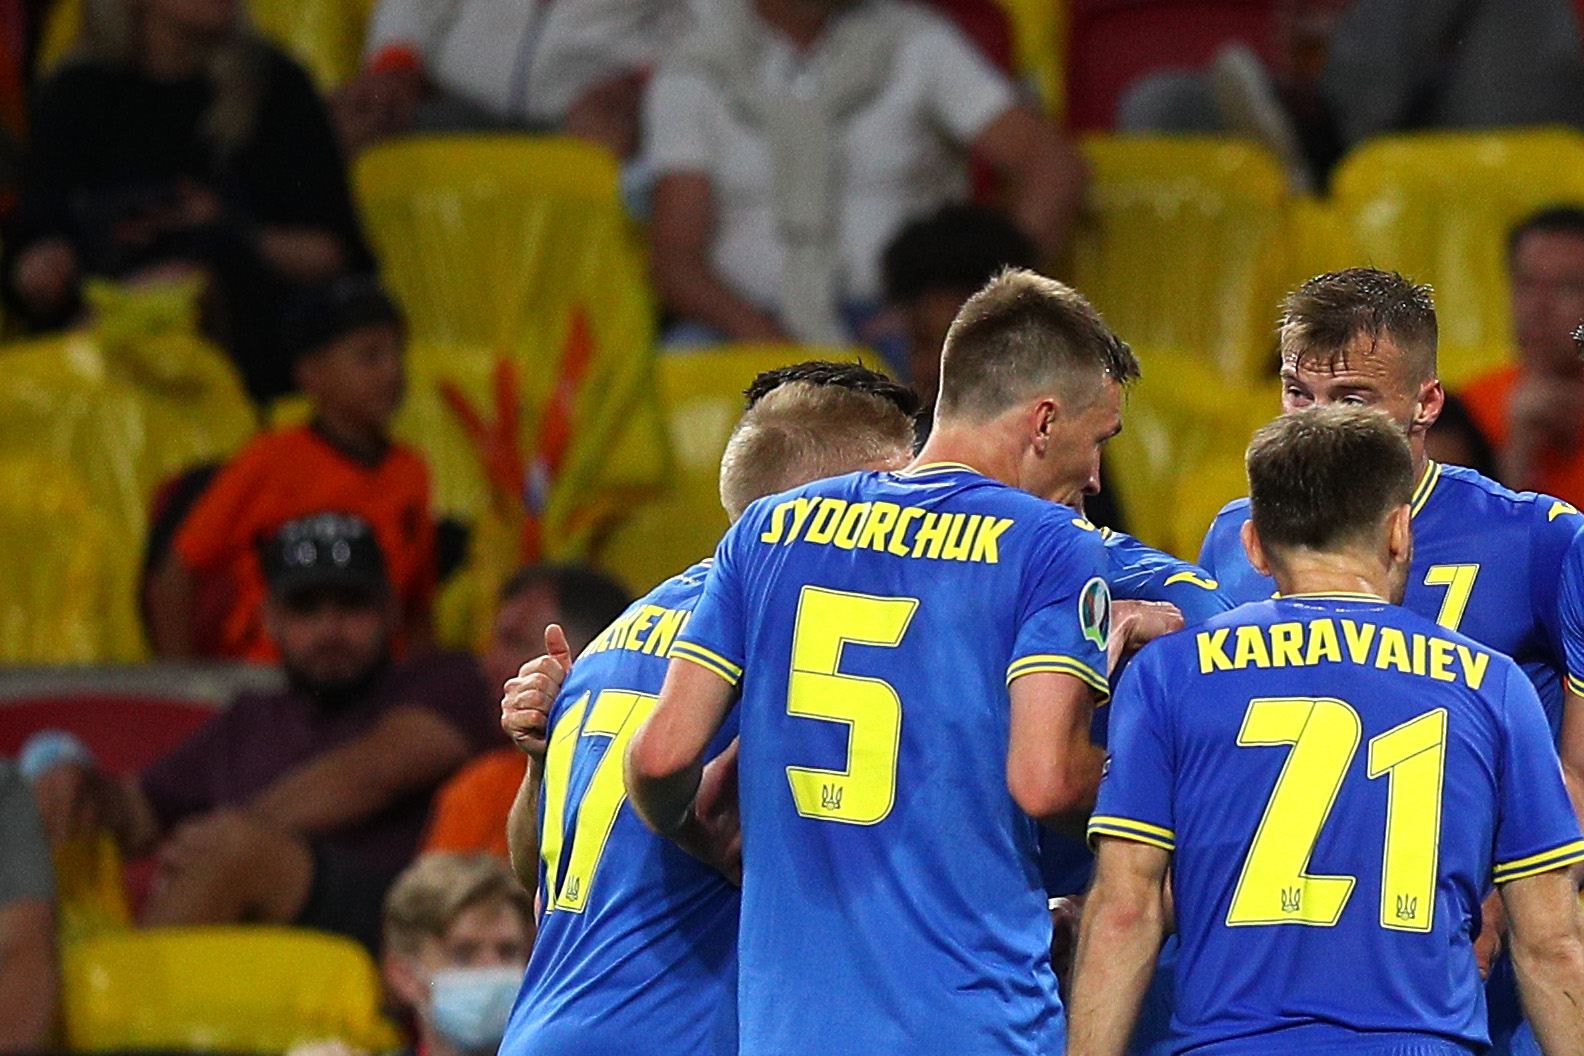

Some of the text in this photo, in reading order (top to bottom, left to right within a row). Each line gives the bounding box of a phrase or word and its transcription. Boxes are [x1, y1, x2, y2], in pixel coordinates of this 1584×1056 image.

[761, 497, 1013, 564] SYDORCHUK
[1426, 563, 1480, 630] 7
[787, 585, 919, 826] 5
[1196, 617, 1490, 690] KARAVAIEV
[538, 688, 661, 914] 17
[1225, 696, 1448, 934] 21
